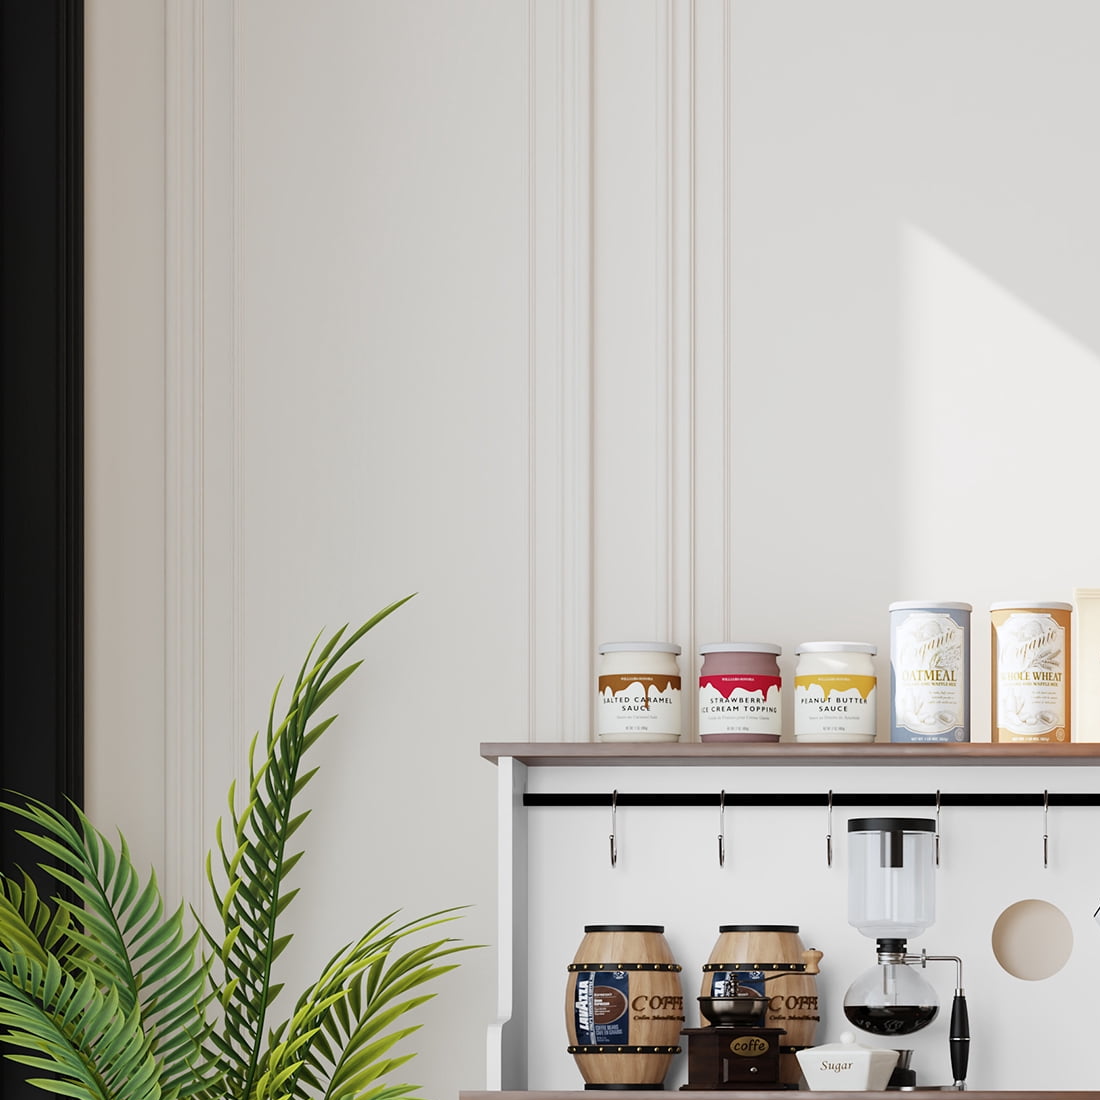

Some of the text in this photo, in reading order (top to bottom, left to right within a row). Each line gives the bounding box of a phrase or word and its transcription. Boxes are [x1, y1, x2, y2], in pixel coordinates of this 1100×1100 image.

[1032, 671, 1062, 682] WHEAT
[603, 696, 672, 704] SALTED CARAMEL
[744, 706, 777, 714] TOPPING
[734, 1038, 766, 1052] coffe
[820, 1060, 853, 1073] Sugar
